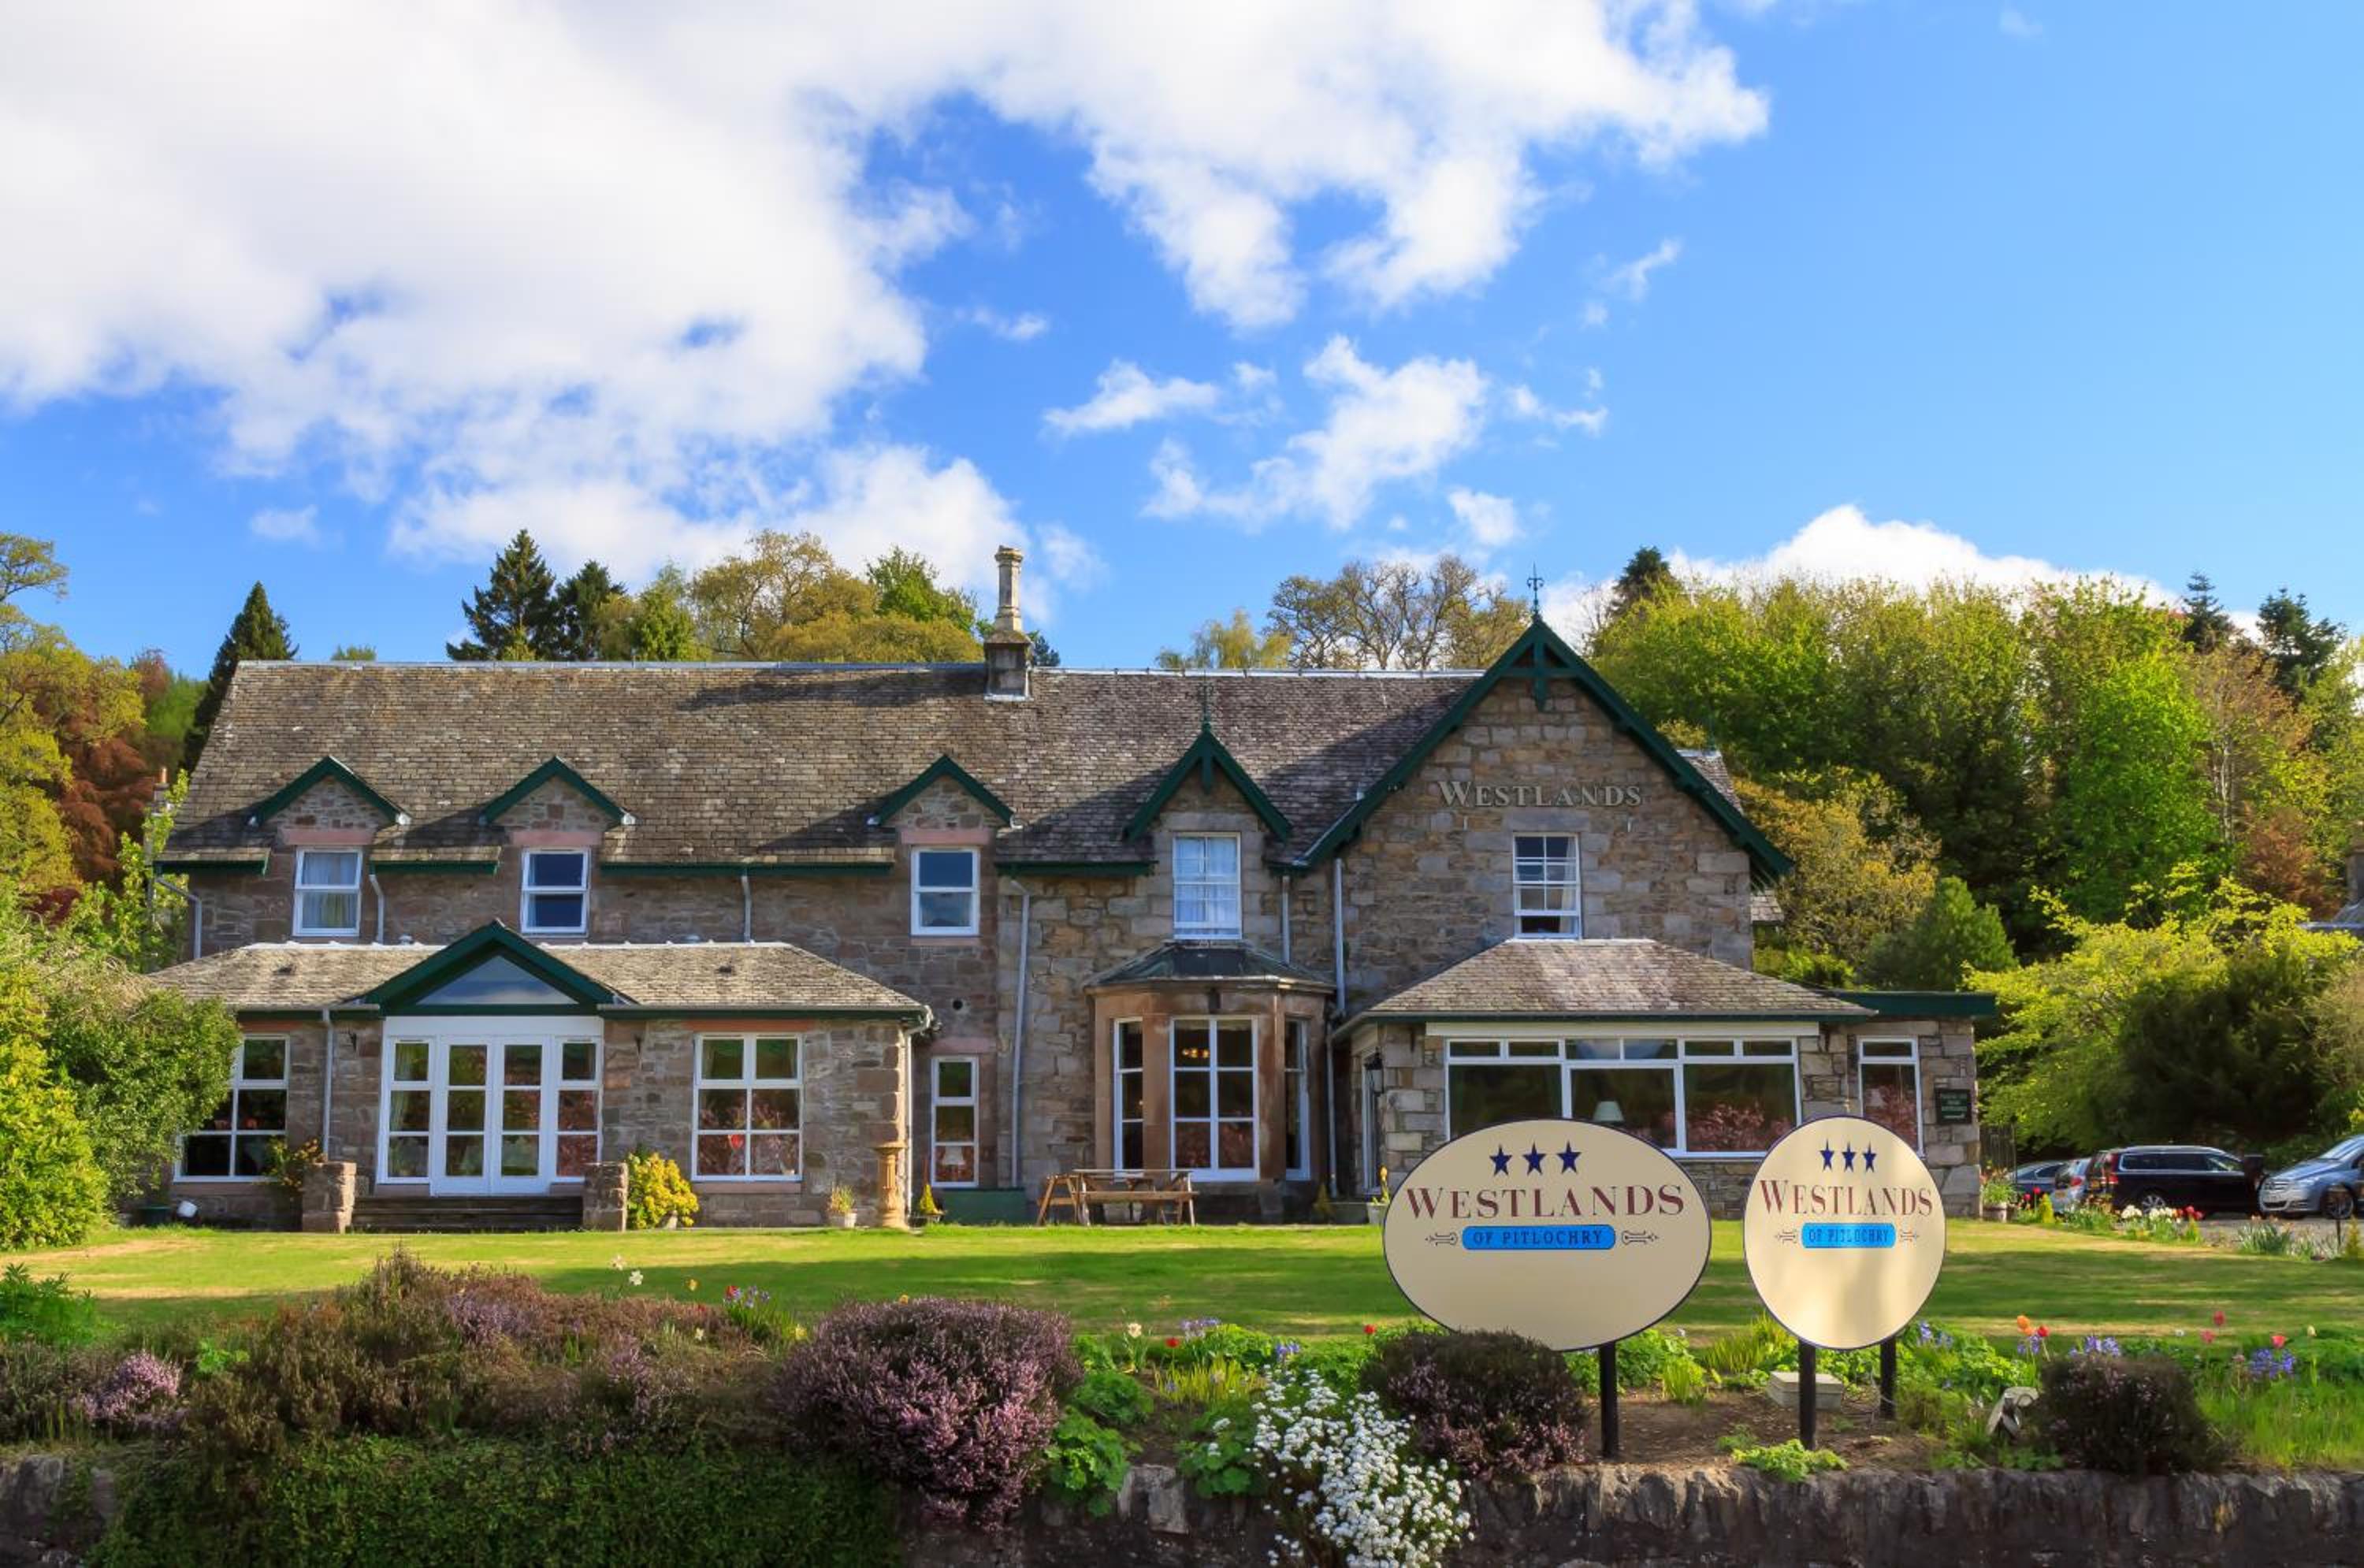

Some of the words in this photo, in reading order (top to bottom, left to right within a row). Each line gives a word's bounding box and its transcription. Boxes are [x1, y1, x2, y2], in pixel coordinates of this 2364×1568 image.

[1437, 780, 1642, 808] WESTLANDS
[1407, 1183, 1685, 1220] WESTLANDS
[1759, 1180, 1933, 1217] WESTLANDS
[1473, 1232, 1494, 1246] OF
[1502, 1229, 1603, 1245] PITLOCHRY
[1808, 1229, 1822, 1243] OF
[1827, 1228, 1890, 1243] PITLOCHRY
